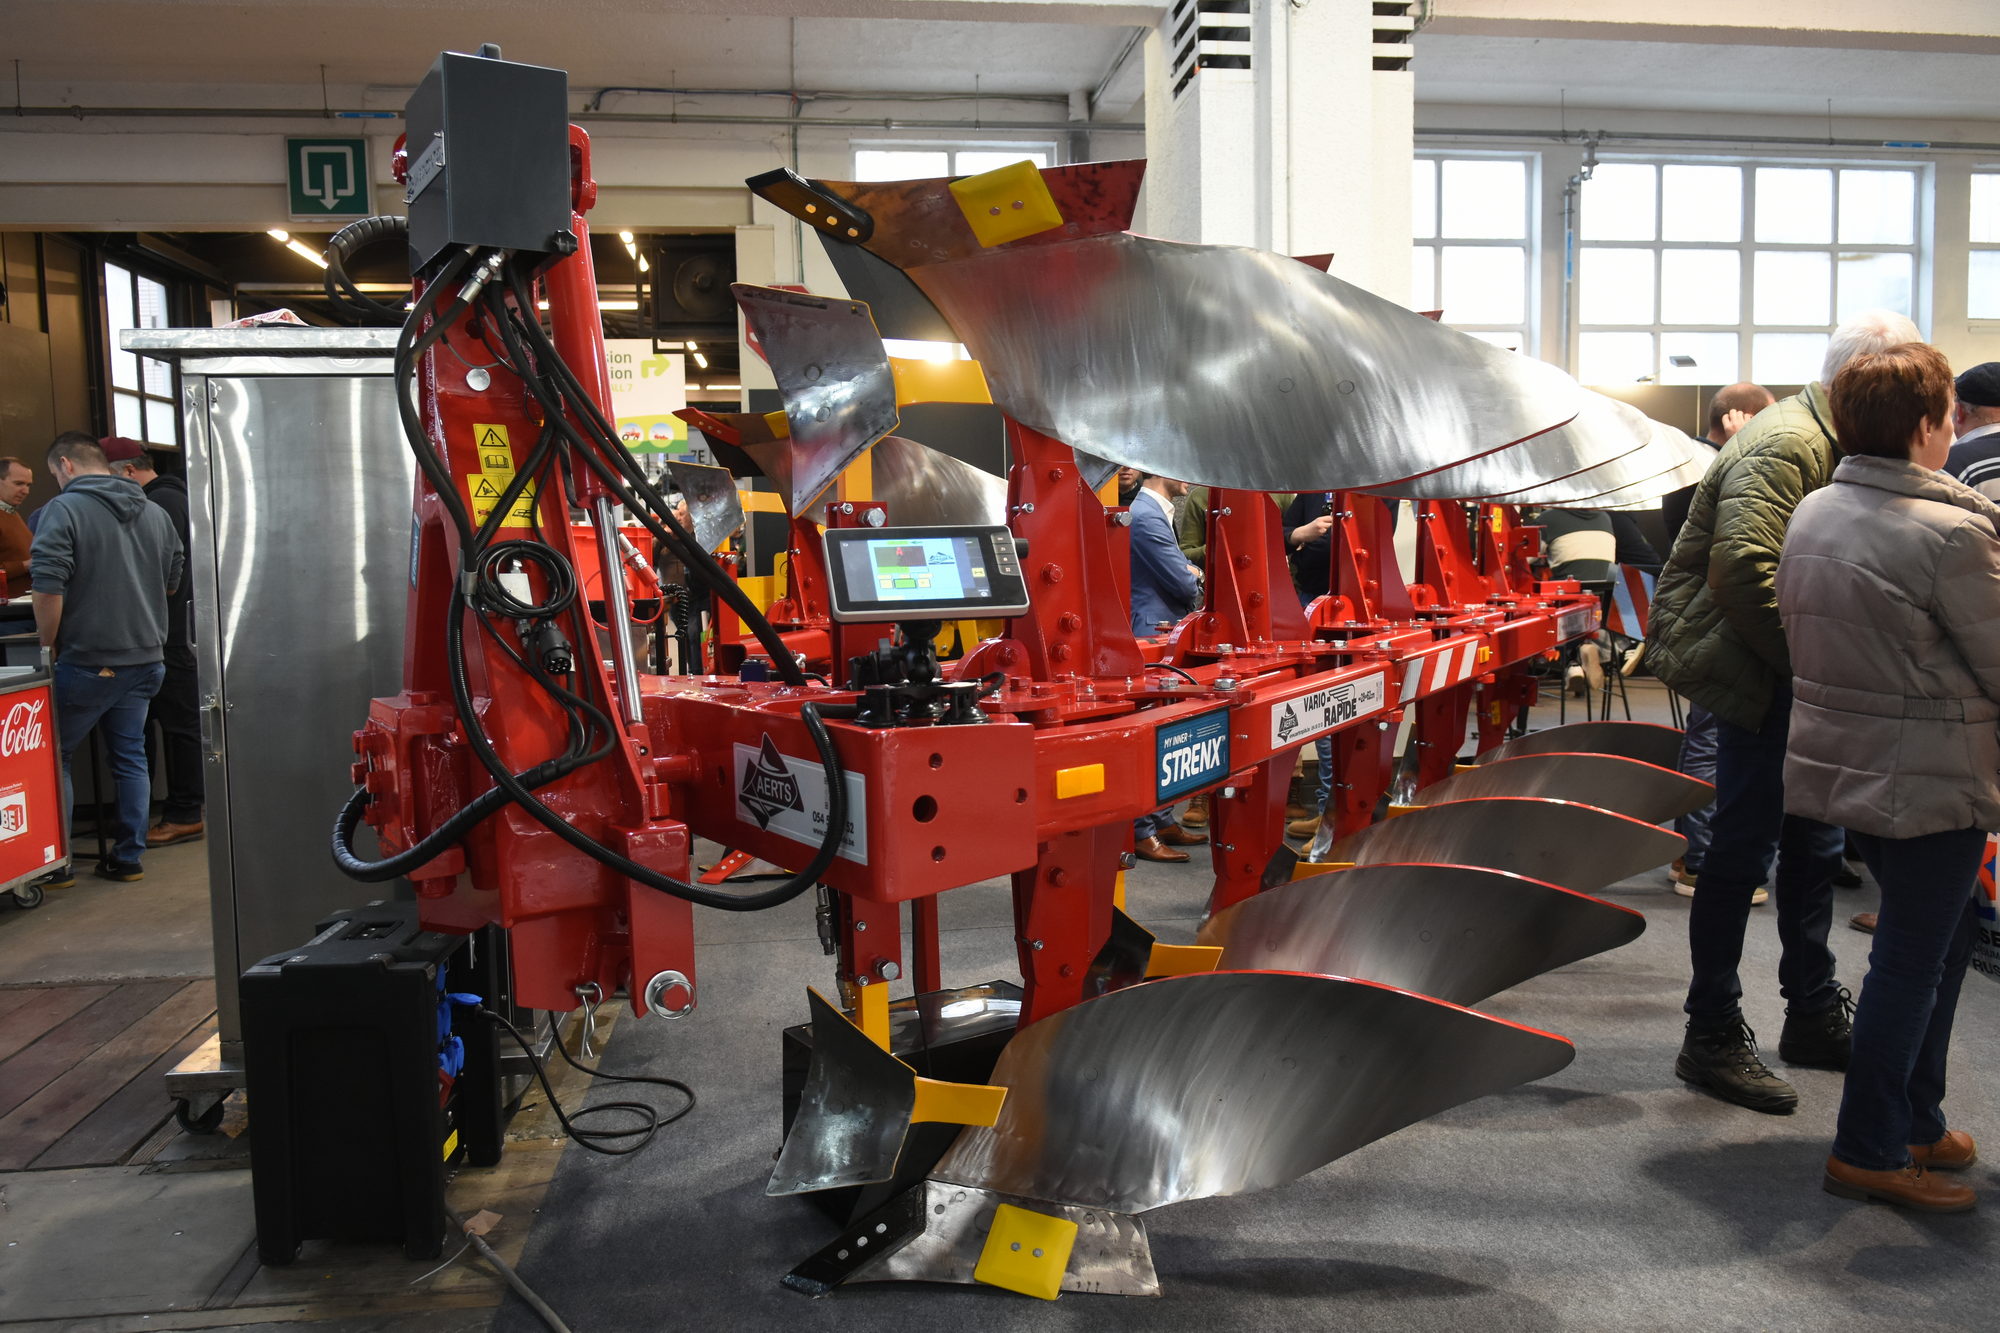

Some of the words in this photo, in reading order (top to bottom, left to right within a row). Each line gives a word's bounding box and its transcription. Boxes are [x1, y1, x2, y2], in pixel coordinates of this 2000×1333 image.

[610, 367, 632, 379] ion
[1324, 698, 1357, 727] RAPIDE
[1164, 738, 1172, 749] MY
[1172, 732, 1188, 746] INNER
[757, 775, 792, 802] AERTS
[812, 811, 825, 825] 054
